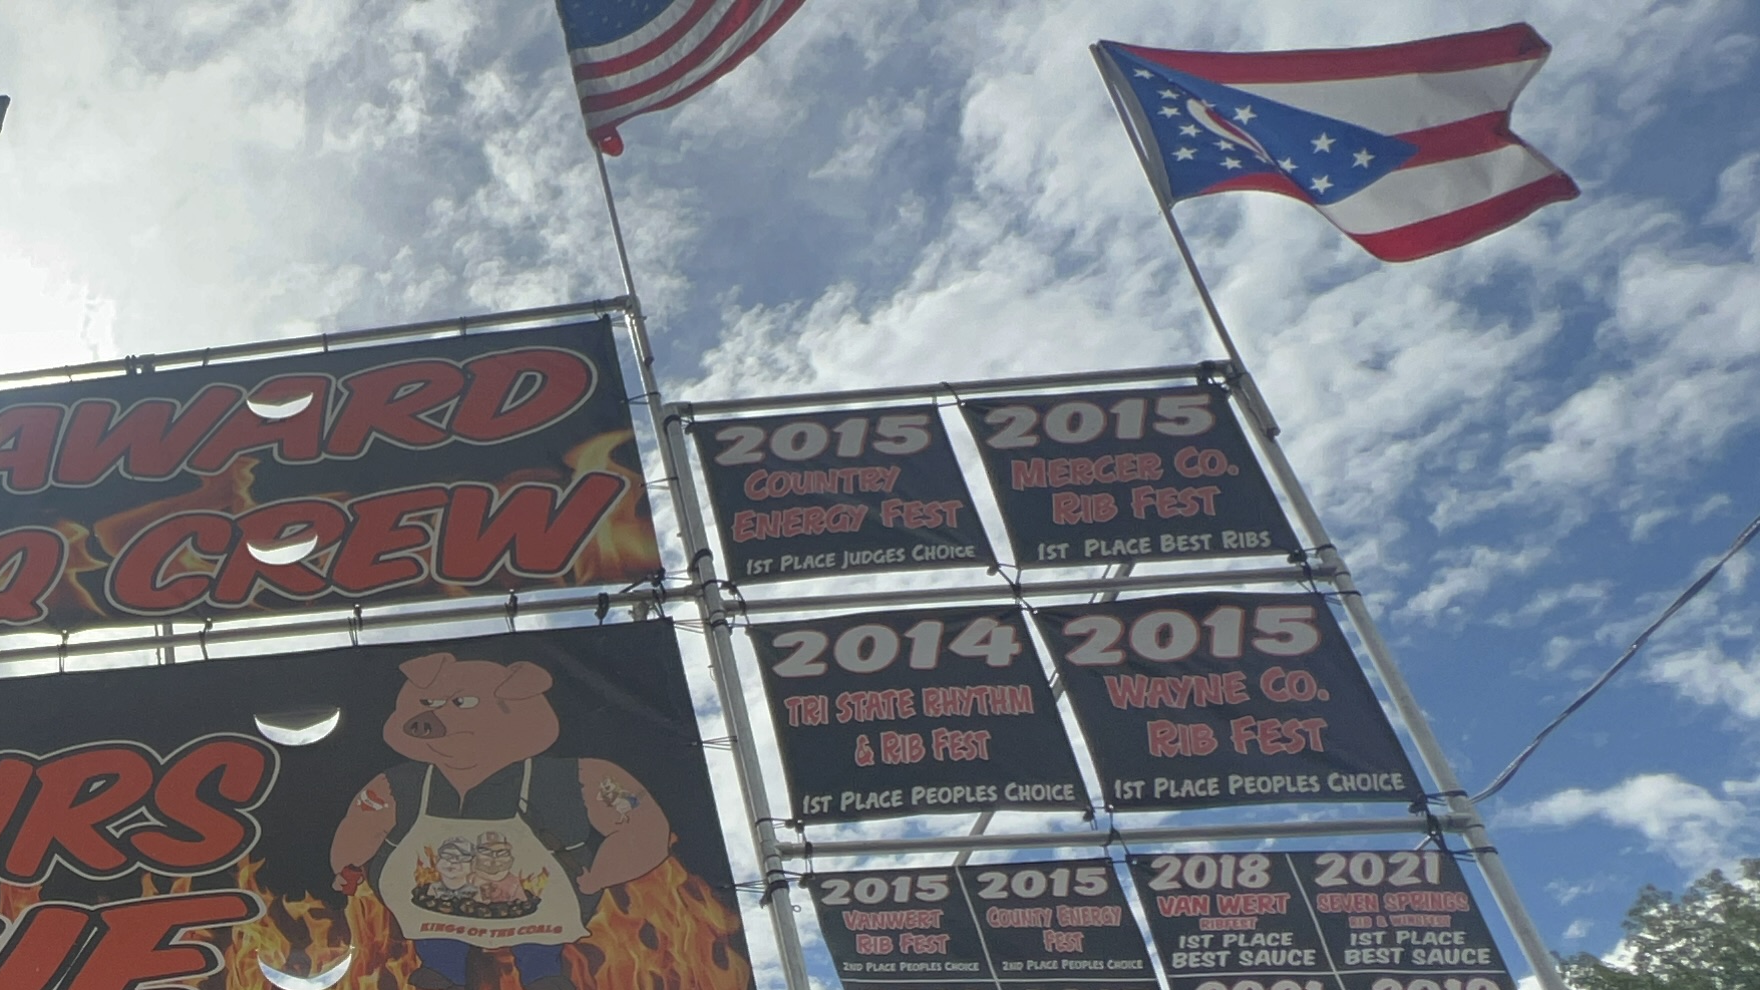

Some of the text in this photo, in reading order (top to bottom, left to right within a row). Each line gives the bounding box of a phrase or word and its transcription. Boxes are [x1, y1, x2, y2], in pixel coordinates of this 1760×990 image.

[984, 393, 1216, 449] 2015
[1010, 446, 1239, 491] MERCER CO.
[1052, 486, 1221, 525] RIB FEST
[103, 471, 628, 614] CREW
[1084, 537, 1152, 558] PLACE
[1160, 534, 1212, 553] BEST
[1222, 530, 1271, 549] RIBS
[1147, 854, 1272, 891] 2018
[1315, 851, 1441, 888] 2021
[1157, 893, 1291, 917] VAN WERT
[1199, 917, 1258, 931] RIBFEST
[1223, 932, 1293, 948] PLACE
[1172, 949, 1316, 969] BEST SAUCE
